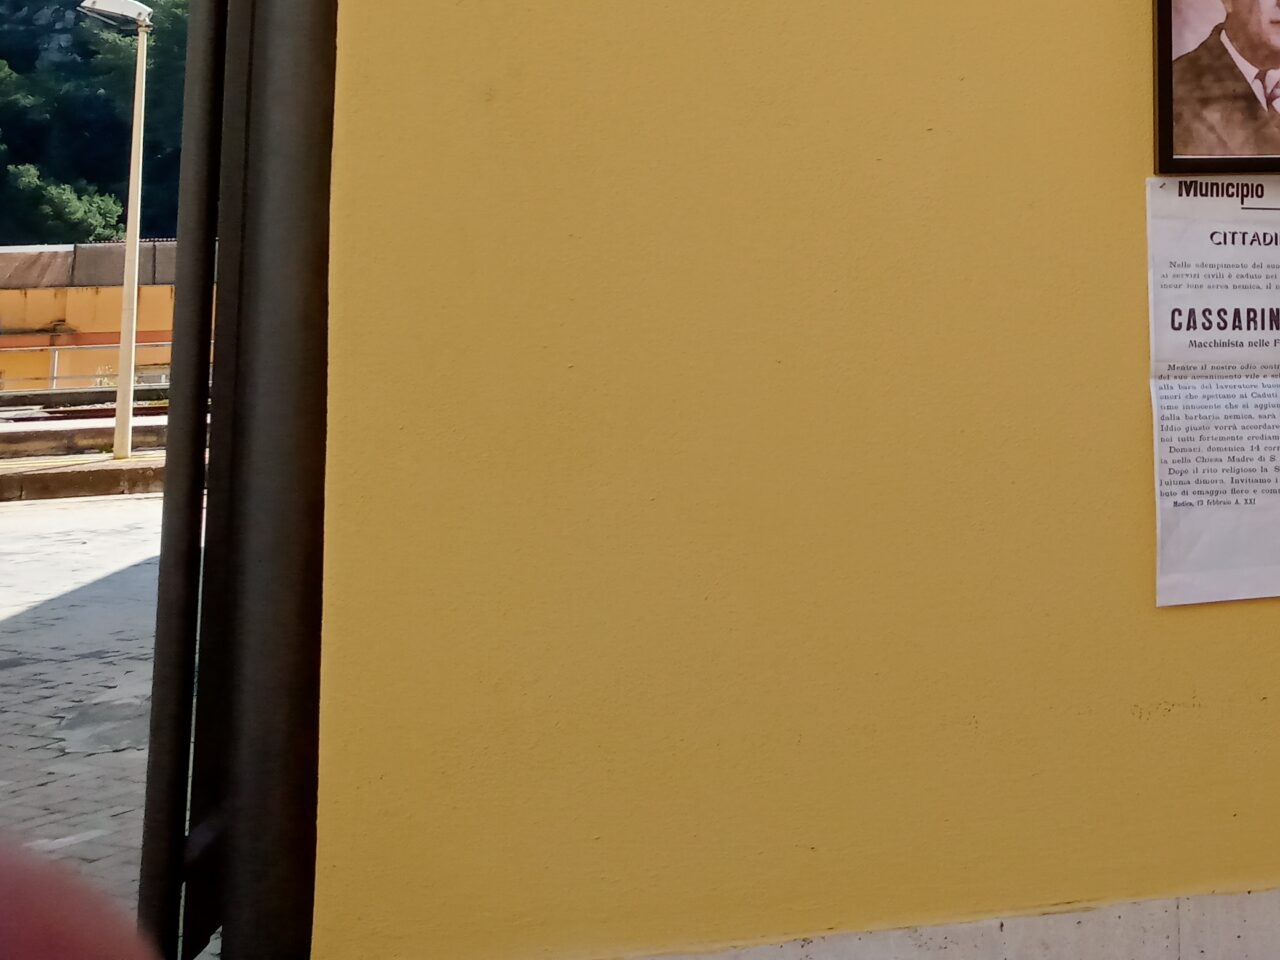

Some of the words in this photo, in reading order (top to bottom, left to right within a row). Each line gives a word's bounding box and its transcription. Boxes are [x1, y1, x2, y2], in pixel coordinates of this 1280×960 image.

[1178, 180, 1264, 205] Municipio
[1189, 339, 1244, 348] Macchinista
[1248, 339, 1269, 347] nelle
